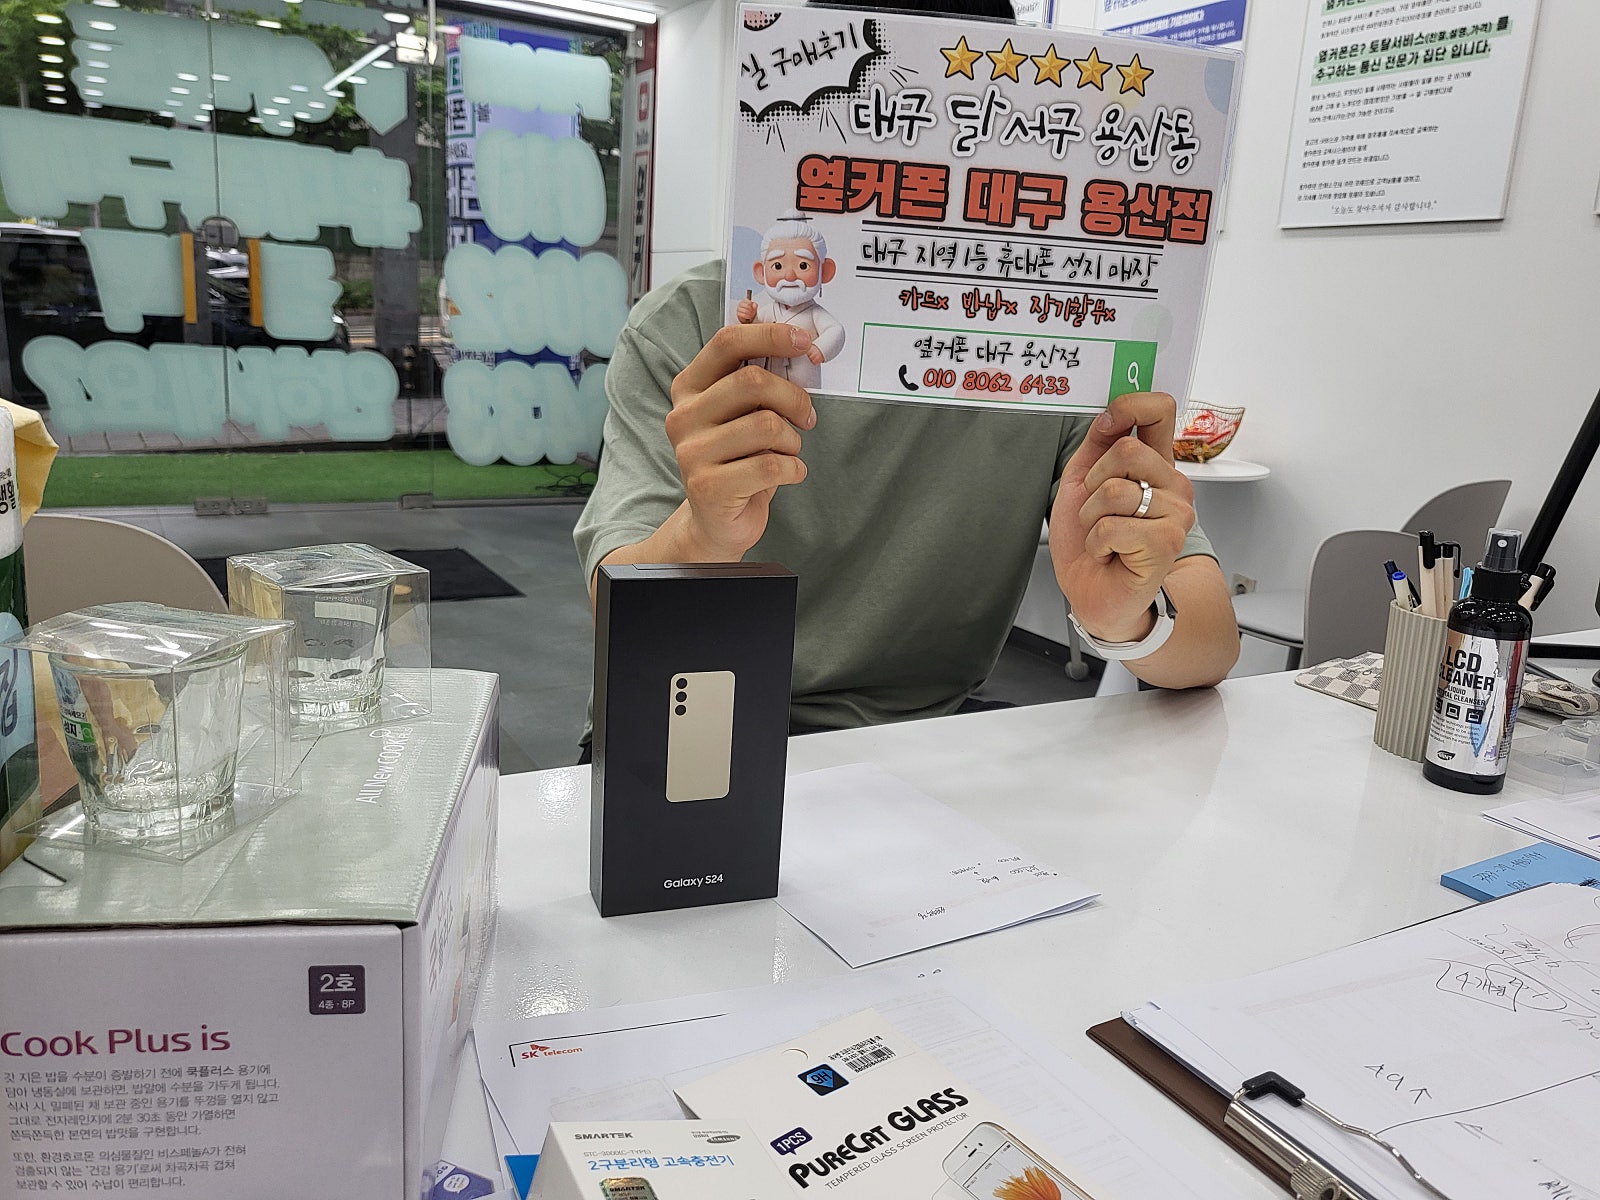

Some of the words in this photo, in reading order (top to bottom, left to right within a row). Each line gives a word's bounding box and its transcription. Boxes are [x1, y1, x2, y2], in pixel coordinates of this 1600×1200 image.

[771, 22, 858, 76] 구매후기
[1315, 64, 1357, 81] 추구하는
[1360, 58, 1382, 74] 통신
[1385, 51, 1420, 71] 전문가
[1423, 46, 1447, 64] 집단
[1451, 39, 1492, 59] 입니다.
[853, 88, 934, 144] 대구
[1093, 106, 1198, 171] 용산동
[798, 155, 950, 221] 옆커폰
[963, 167, 1068, 230] 대구
[1081, 179, 1213, 245] 용산점
[862, 236, 908, 266] 대구
[916, 241, 957, 269] 지역
[997, 242, 1055, 278] 휴대폰
[1062, 252, 1101, 280] 성지
[1108, 255, 1158, 287] 매장
[914, 335, 969, 362] 옆커폰
[977, 339, 1014, 365] 대구
[1021, 340, 1080, 369] 용산점
[923, 367, 957, 389] 010
[962, 370, 1012, 393] 8062
[1019, 374, 1071, 395] 6433
[1446, 645, 1483, 673] LCD
[363, 763, 394, 787] New
[663, 878, 704, 889] Galaxy
[705, 874, 724, 884] S24
[320, 973, 357, 993] 2호
[0, 1030, 99, 1057] Cook
[108, 1028, 192, 1054] Plus
[201, 1024, 231, 1051] is
[521, 1050, 539, 1060] SK
[543, 1047, 583, 1057] telecom
[20, 1071, 42, 1083] 지은
[72, 1069, 107, 1082] 수분이
[111, 1068, 156, 1081] 증발하기
[161, 1067, 182, 1079] 전에
[186, 1065, 234, 1078] 쿡플러스
[238, 1064, 271, 1076] 용기에
[810, 1069, 833, 1086] 9H
[170, 1081, 203, 1093] 수분을
[208, 1079, 240, 1091] 가두게
[7, 1101, 29, 1113] 식사
[104, 1098, 127, 1110] 보관
[157, 1096, 189, 1108] 용기를
[194, 1095, 227, 1106] 뚜껑을
[231, 1093, 253, 1105] 열지
[257, 1092, 280, 1104] 않고
[887, 1087, 969, 1132] GLASS
[8, 1115, 42, 1127] 그대로
[46, 1113, 112, 1127] 전자레인지에
[115, 1113, 133, 1125] 2분
[137, 1112, 160, 1123] 30초
[166, 1111, 188, 1122] 동안
[192, 1108, 236, 1121] 가열하면
[105, 1126, 139, 1139] 밥맛을
[143, 1125, 202, 1138] 구현합니다.
[574, 1131, 633, 1140] SMARTEK
[776, 1130, 807, 1153] 1PCS
[224, 1145, 247, 1156] 전혀
[825, 1161, 870, 1190] TEMPERED
[870, 1148, 898, 1165] GLASS
[899, 1131, 927, 1151] SCREEN
[928, 1112, 968, 1135] PROTECTOR
[60, 1165, 83, 1177] 않는
[166, 1161, 210, 1172] 차곡차곡
[214, 1159, 236, 1171] 겹쳐
[588, 1157, 660, 1171] 2구분리형
[662, 1154, 734, 1168] 고속충전기
[51, 1179, 62, 1190] 수
[66, 1179, 88, 1191] 있어
[128, 1176, 186, 1190] 편리합니다.
